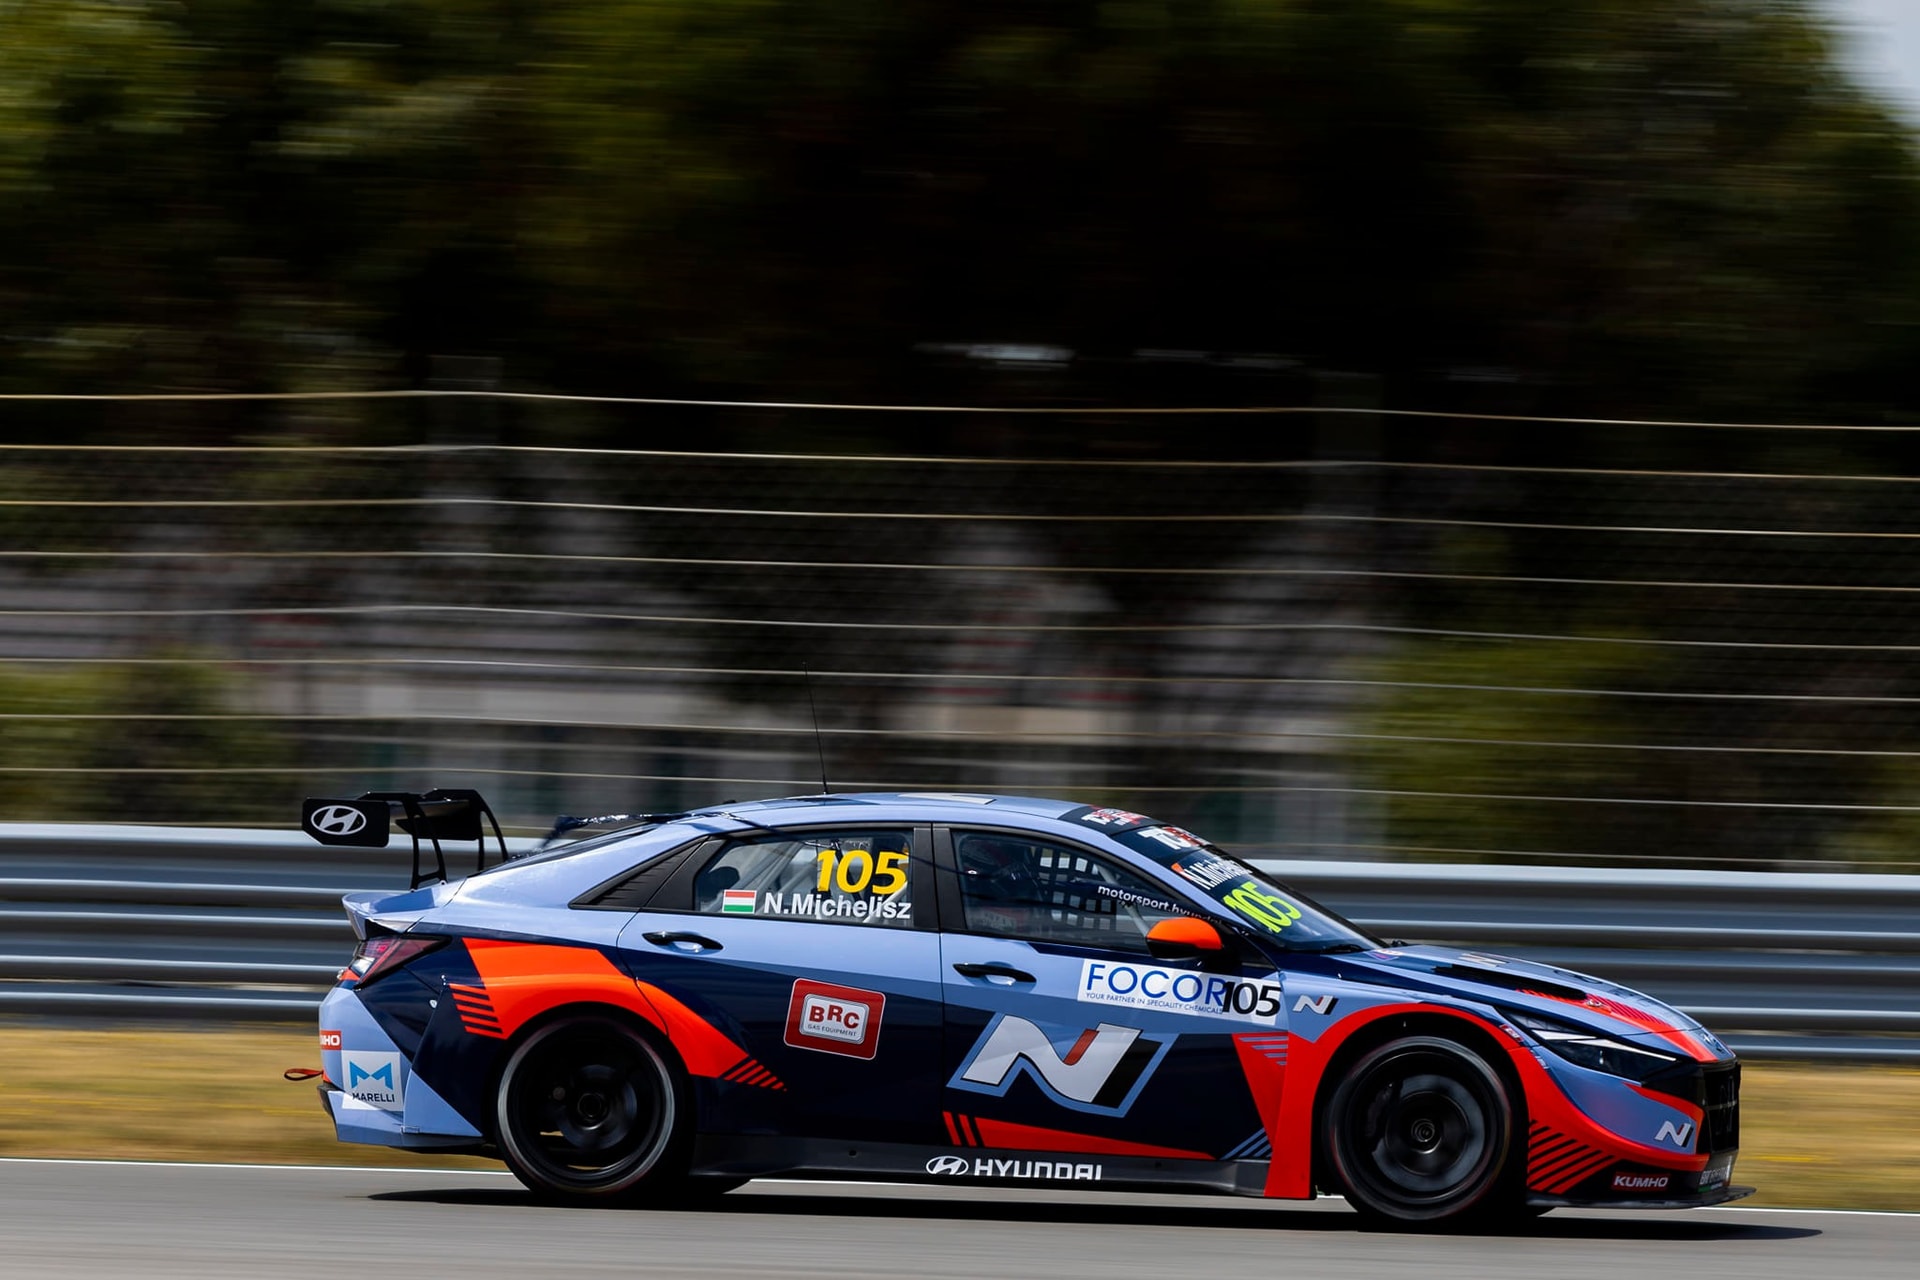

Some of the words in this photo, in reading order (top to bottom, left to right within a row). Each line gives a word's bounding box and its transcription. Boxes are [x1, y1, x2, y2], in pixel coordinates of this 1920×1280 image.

[817, 849, 910, 895] 105
[763, 892, 912, 919] N.Michelisz
[1223, 882, 1302, 933] 105
[1087, 963, 1226, 1007] FOCOR
[1086, 992, 1105, 1000] YOUR
[1106, 994, 1137, 1004] PARTNER
[1147, 999, 1183, 1010] SPECIALITY
[1184, 1003, 1224, 1015] CHEMICALS
[1222, 981, 1282, 1017] 105
[808, 1004, 860, 1029] BRC
[807, 1023, 821, 1031] GAS
[821, 1025, 857, 1037] EQUIPMENT
[352, 1092, 396, 1103] MARELLI
[974, 1158, 1102, 1181] HYUNDAI
[1613, 1175, 1669, 1188] KUMHO
